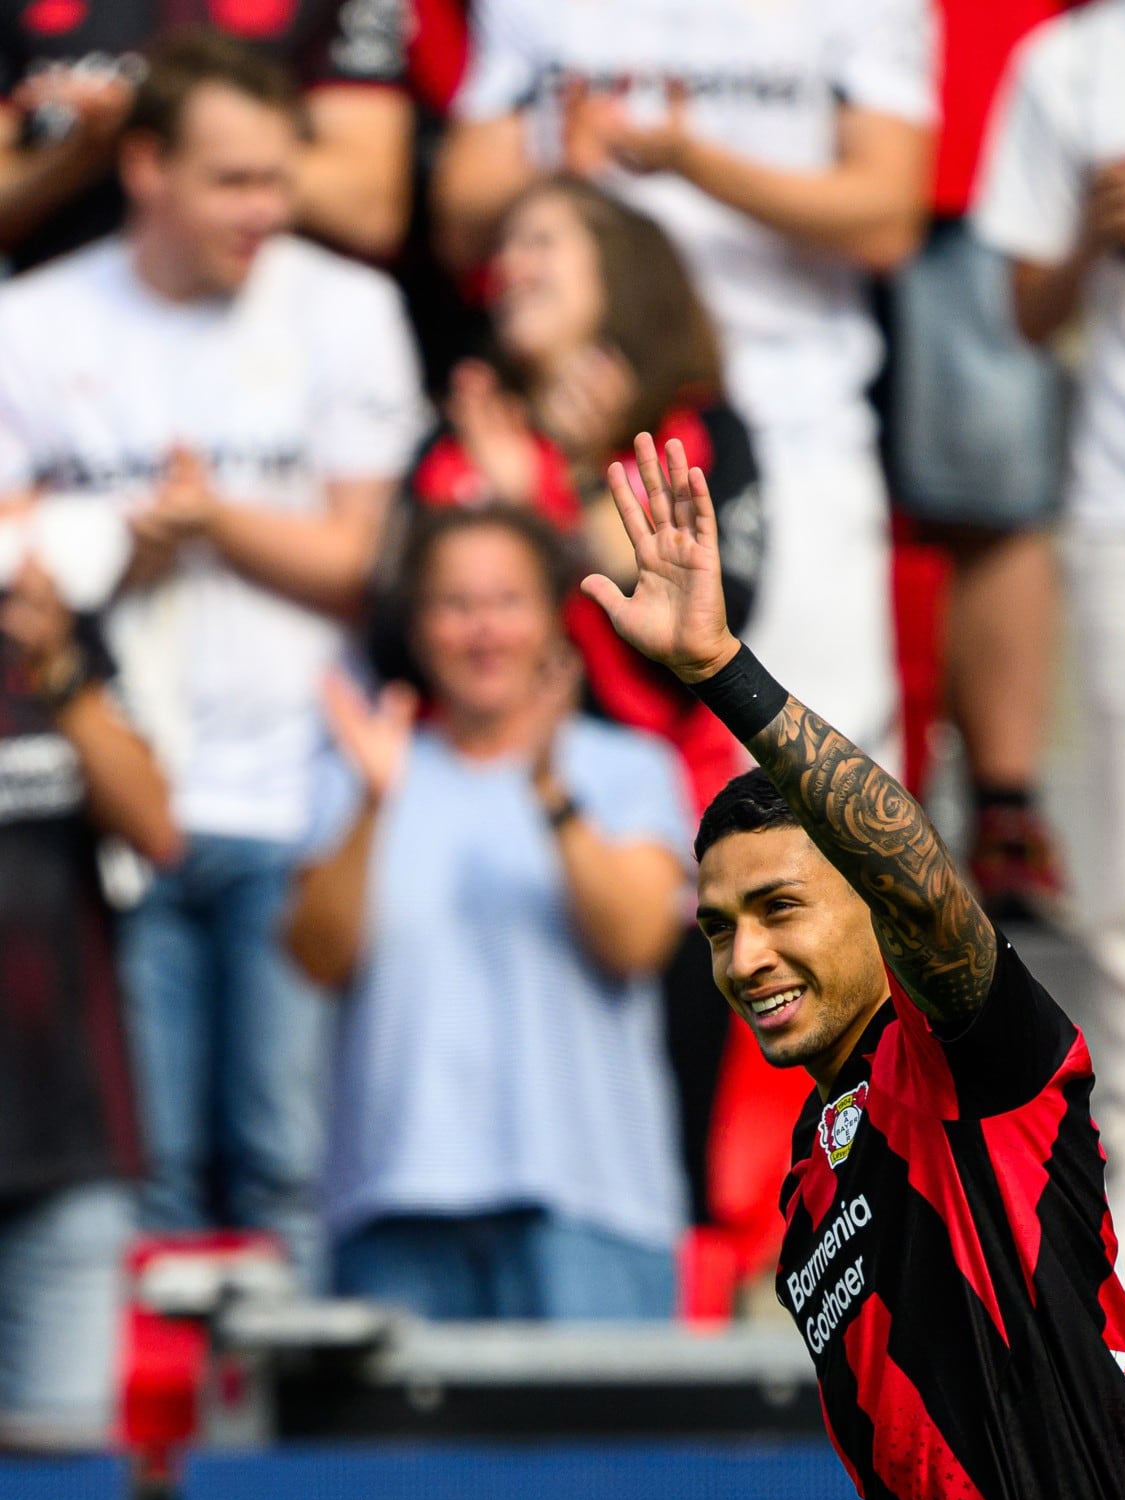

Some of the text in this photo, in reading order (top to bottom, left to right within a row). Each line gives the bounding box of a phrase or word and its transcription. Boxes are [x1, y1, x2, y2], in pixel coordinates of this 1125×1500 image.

[836, 1116, 858, 1136] BAYER
[787, 1194, 873, 1314] Barmenia
[806, 1256, 865, 1355] Gothaer
